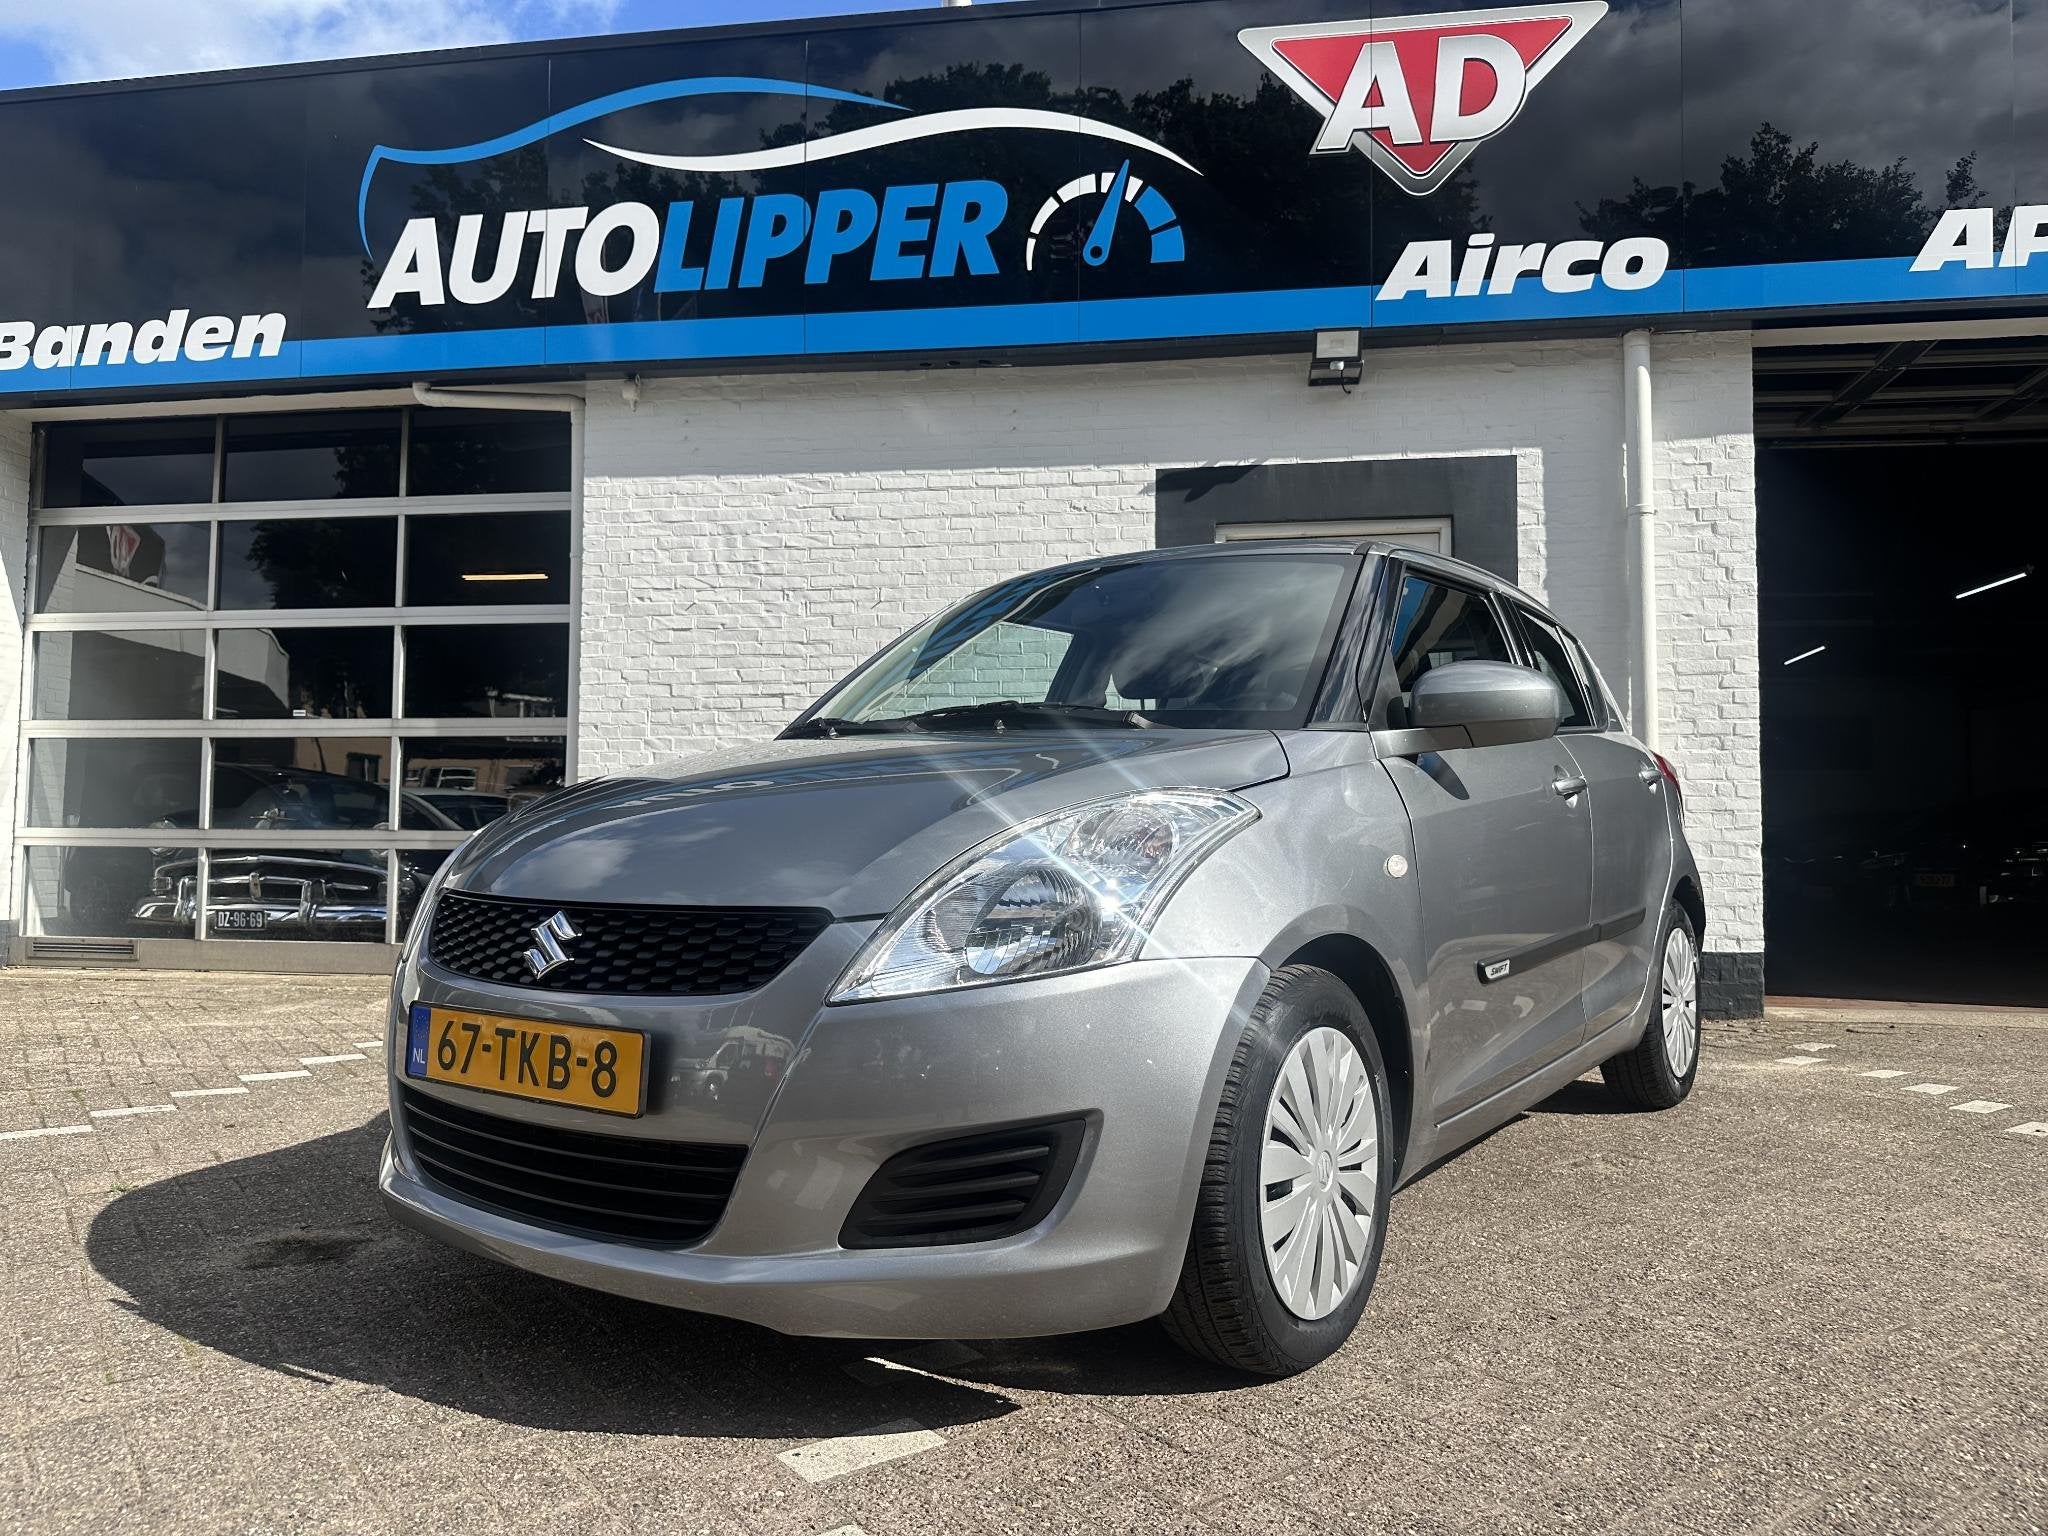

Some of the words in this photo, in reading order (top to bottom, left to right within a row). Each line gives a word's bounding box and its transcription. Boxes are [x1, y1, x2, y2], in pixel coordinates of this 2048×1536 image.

[1315, 33, 1526, 151] AD
[367, 178, 1008, 308] AUTOLIPPER
[1374, 233, 1670, 302] Airco
[0, 308, 287, 371] Banden
[217, 911, 263, 928] DZ-96-69
[412, 1047, 426, 1065] NL
[437, 1020, 618, 1098] 67-TKB-8
